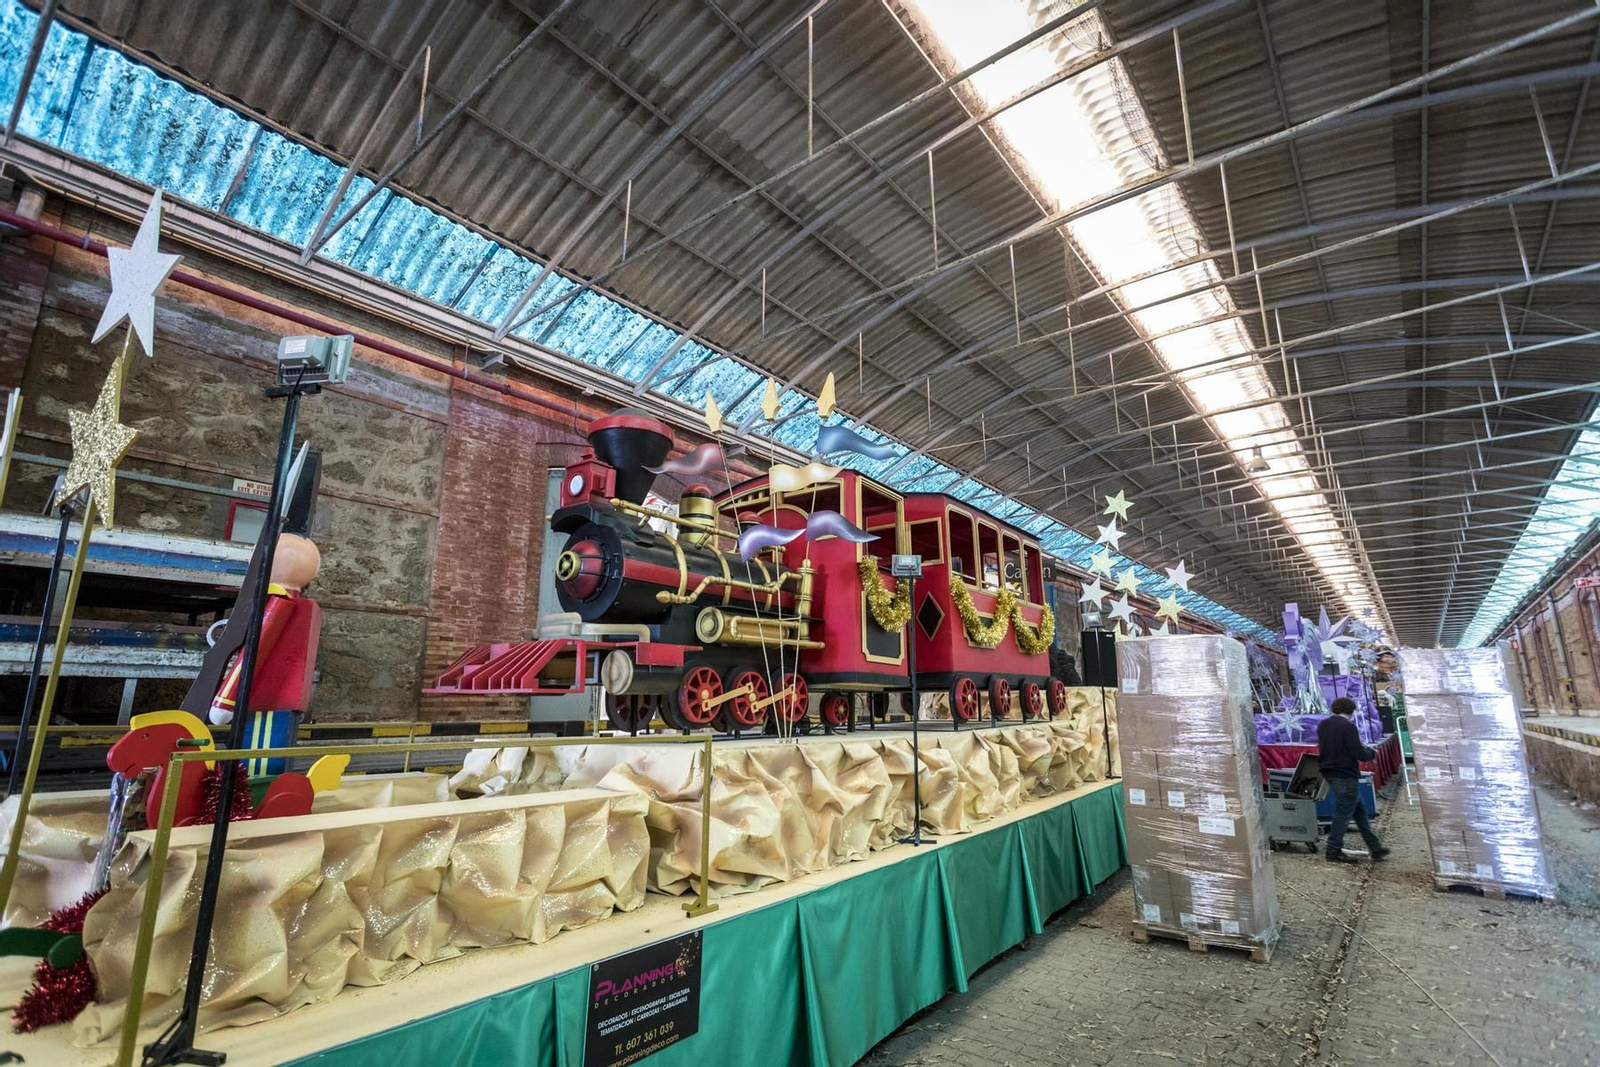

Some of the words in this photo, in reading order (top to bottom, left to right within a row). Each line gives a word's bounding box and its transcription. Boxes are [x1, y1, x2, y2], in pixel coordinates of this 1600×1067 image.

[594, 962, 675, 1002] PLANNING
[594, 974, 675, 1010] DECORADOS
[597, 1011, 628, 1029] DECORADOS
[668, 987, 691, 1001] ESCULTURA
[636, 1007, 660, 1022] CARROZAS
[662, 995, 688, 1010] CABALGATAS
[625, 1035, 642, 1050] 607
[643, 1028, 658, 1043] 361
[659, 1020, 675, 1036] 039
